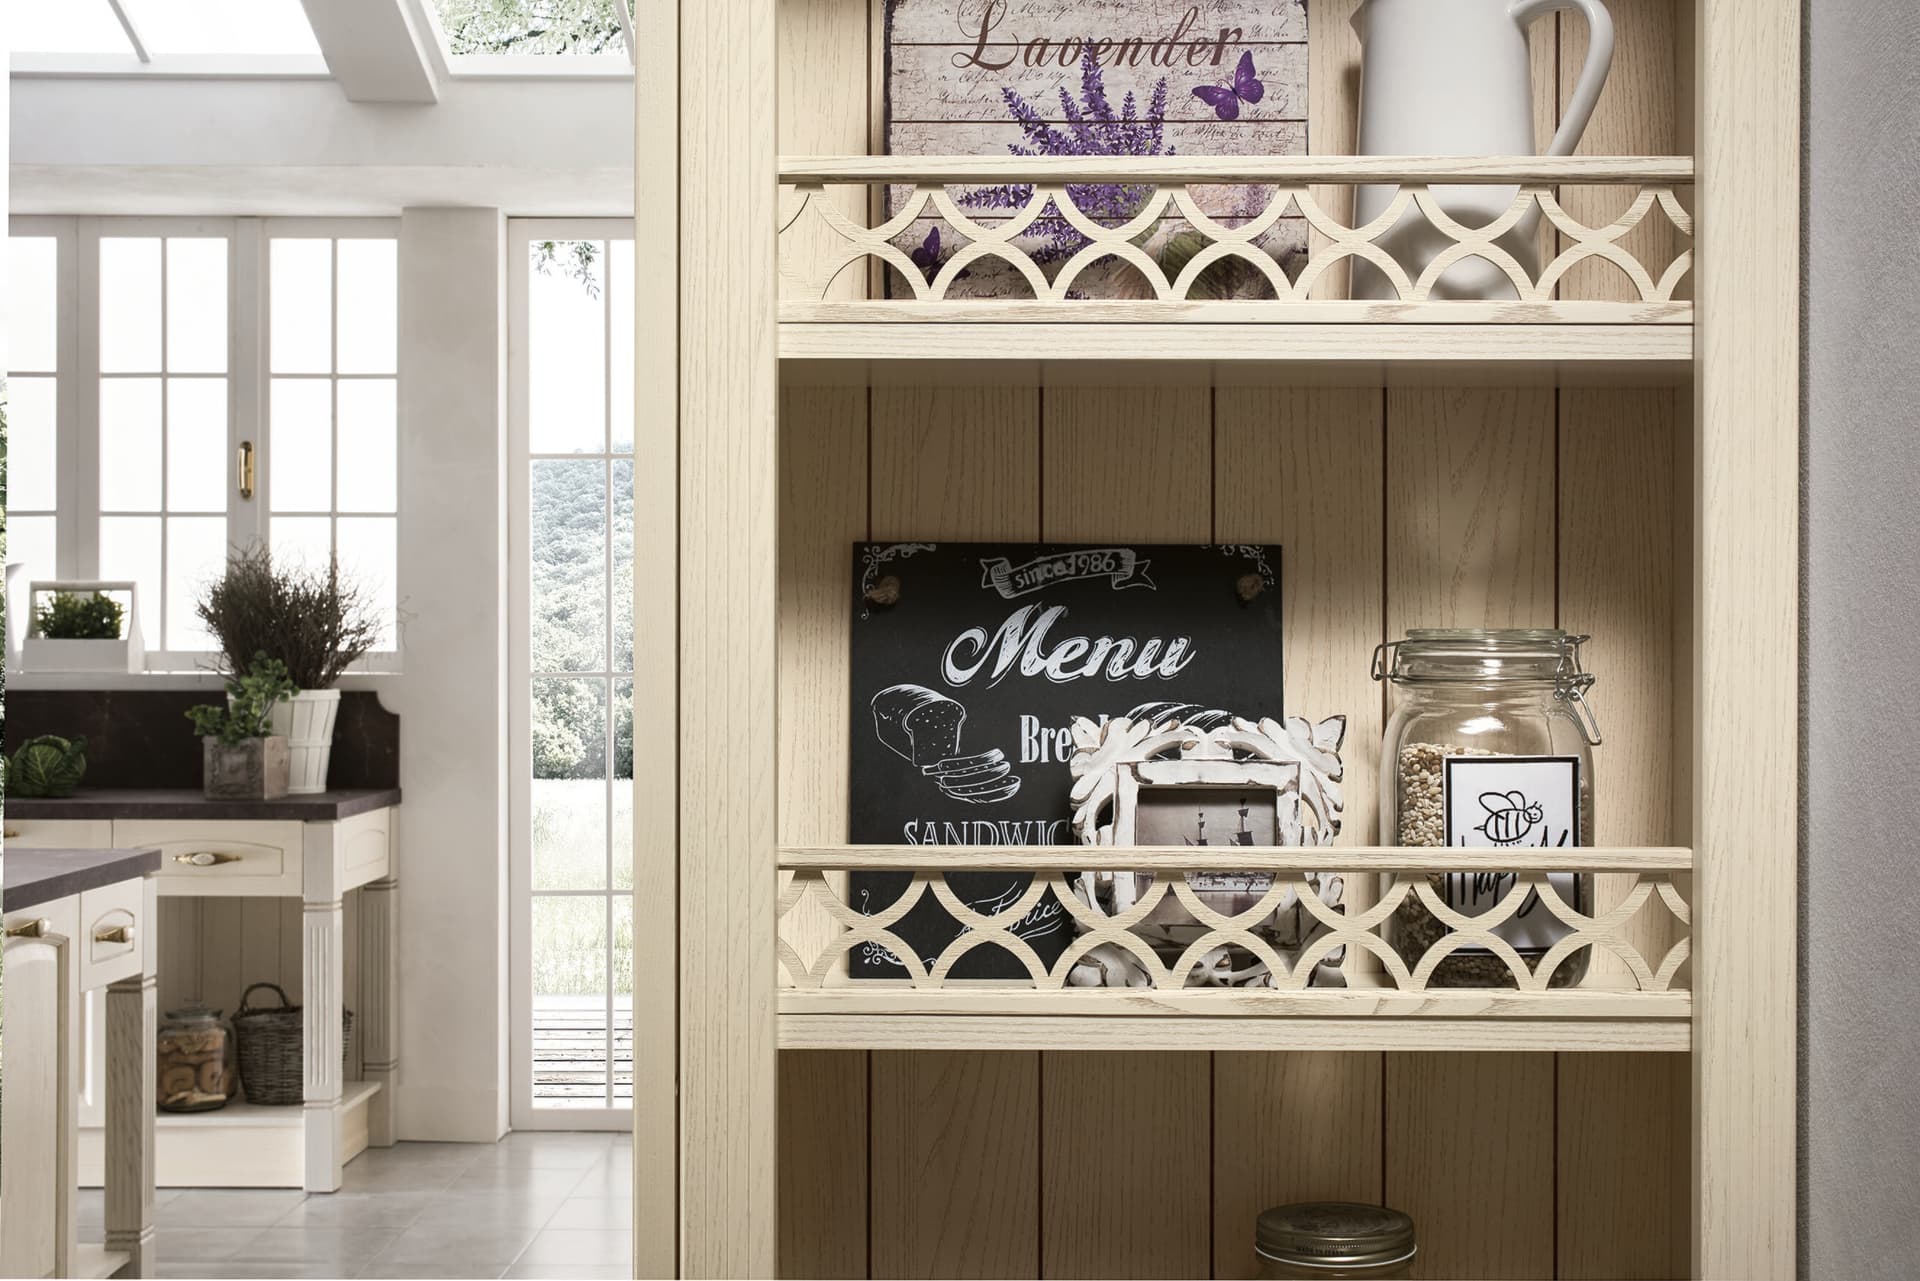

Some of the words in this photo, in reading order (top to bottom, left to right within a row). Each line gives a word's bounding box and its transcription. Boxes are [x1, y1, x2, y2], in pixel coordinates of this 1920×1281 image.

[951, 0, 1243, 71] Lavender
[1065, 552, 1116, 576] 1986
[940, 601, 1197, 689] Menu
[1019, 713, 1110, 764] Bre
[903, 817, 1071, 846] SANDWIC
